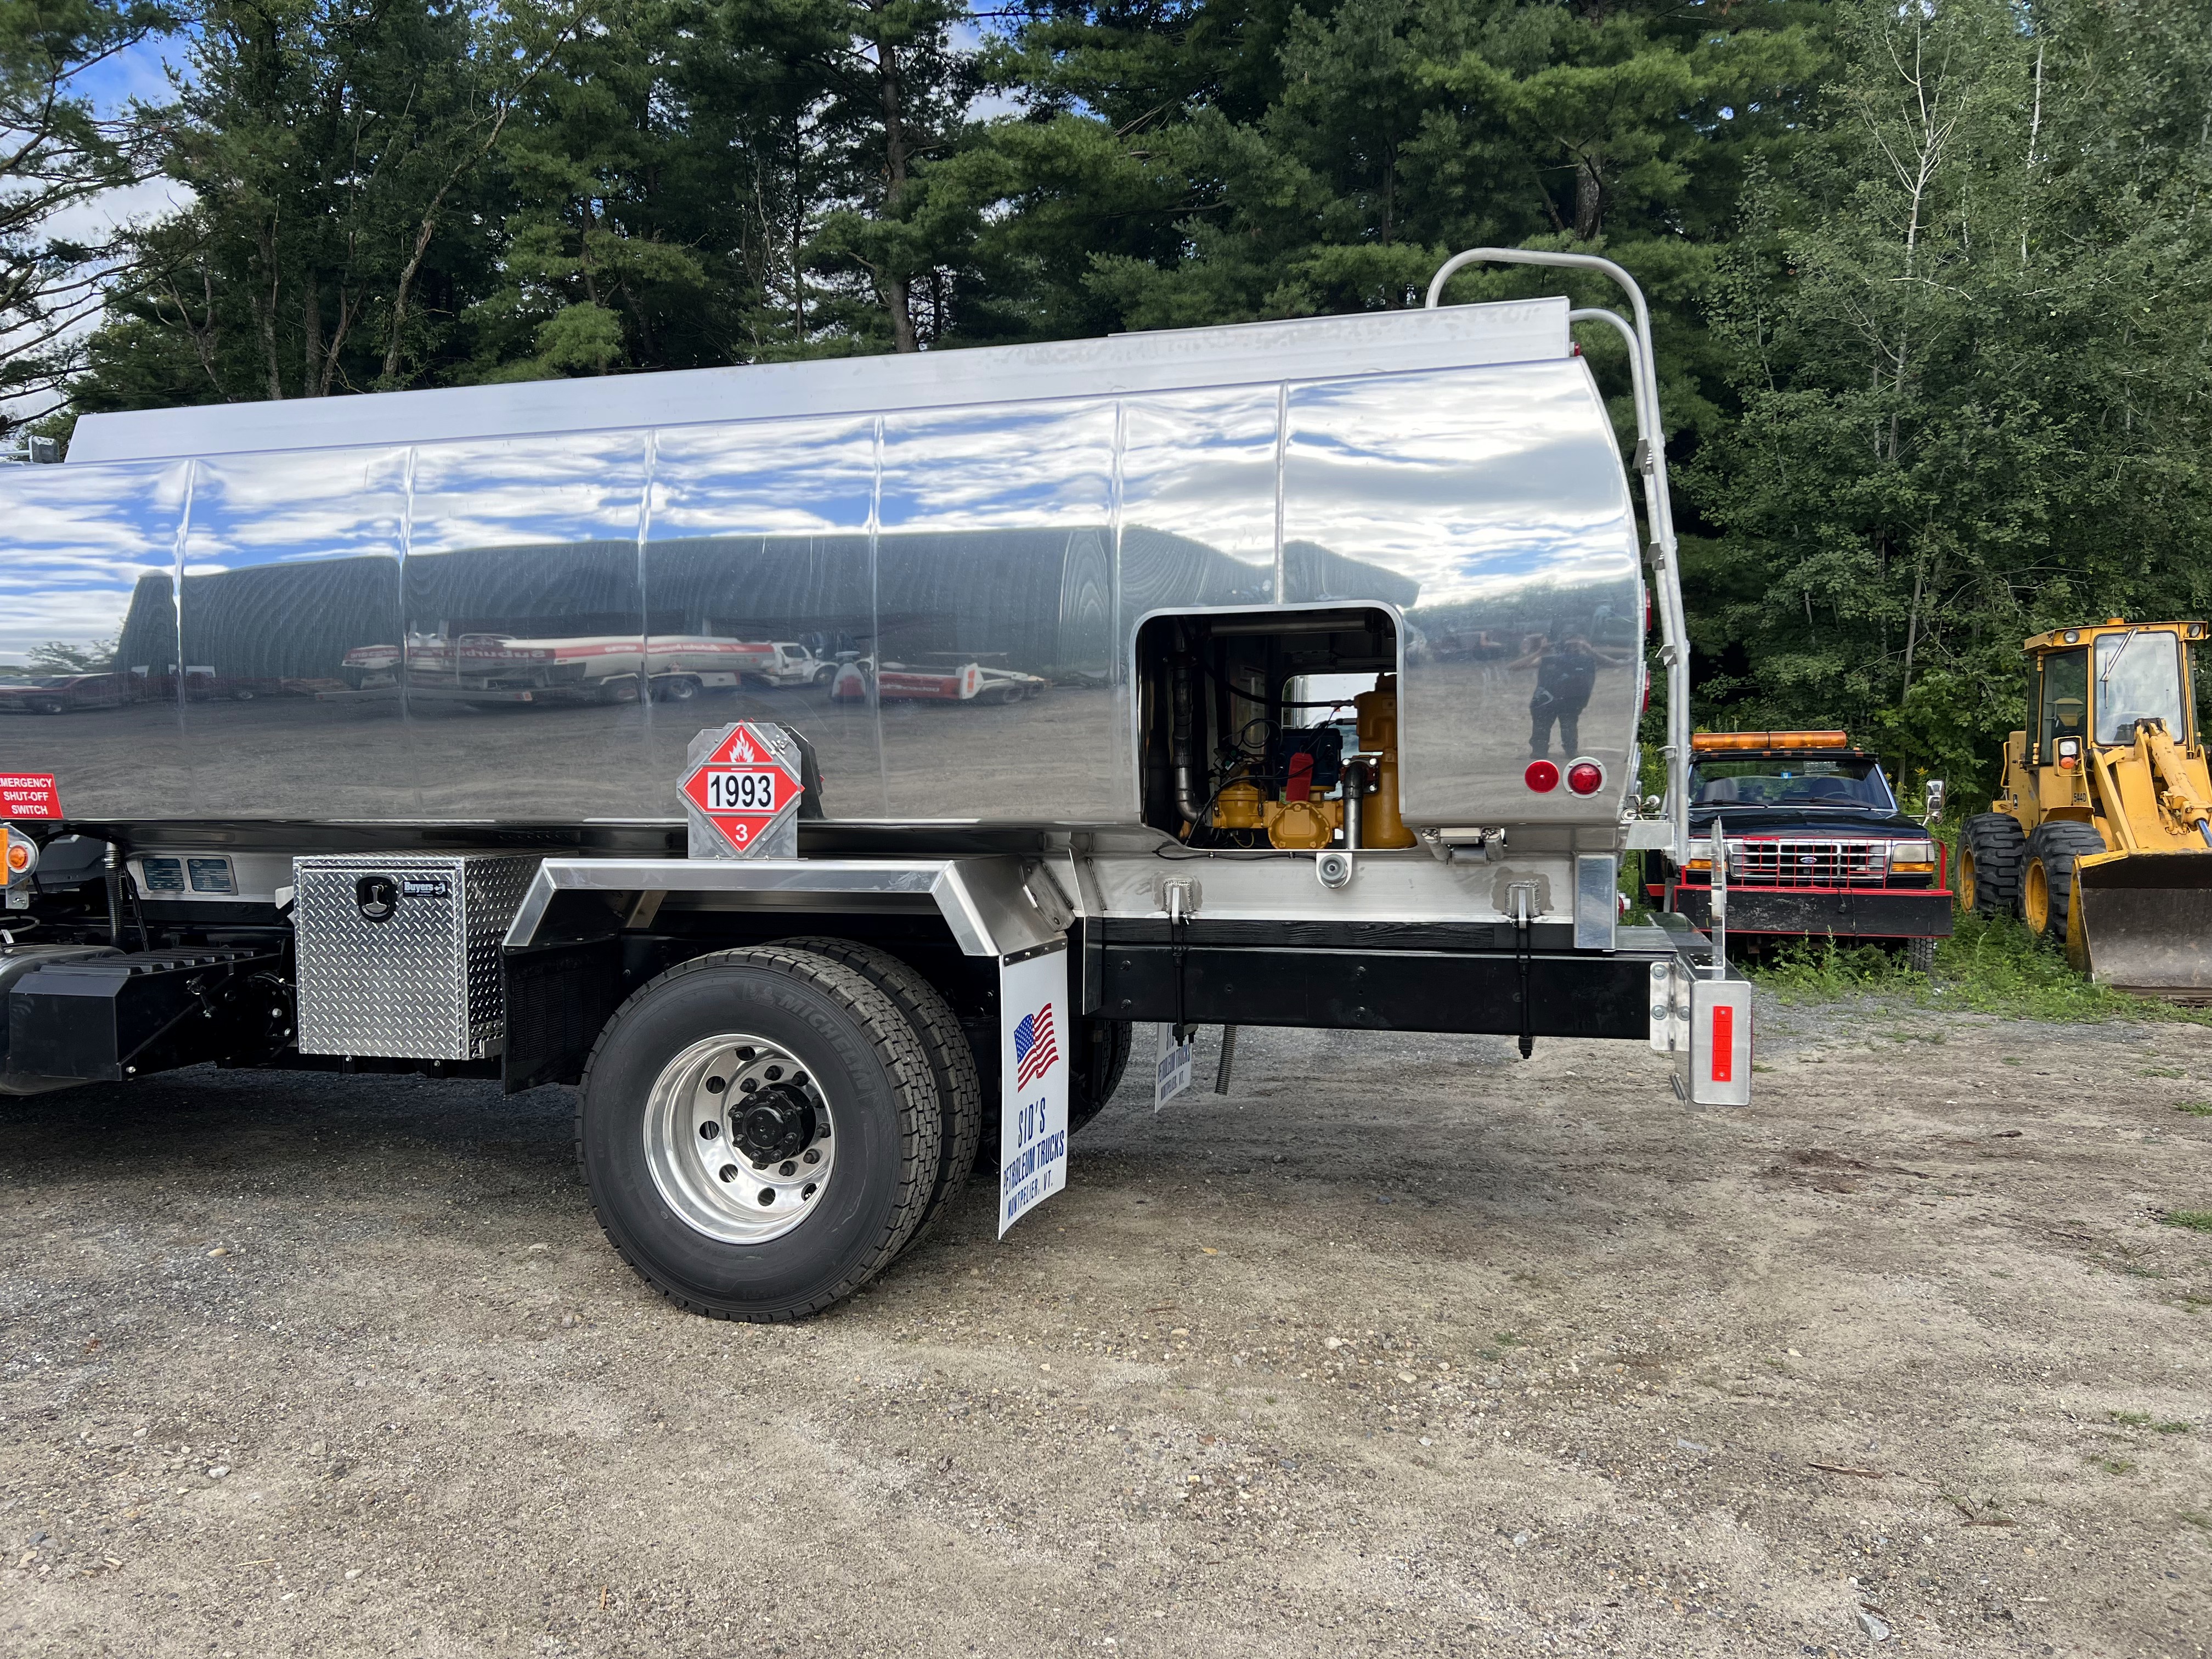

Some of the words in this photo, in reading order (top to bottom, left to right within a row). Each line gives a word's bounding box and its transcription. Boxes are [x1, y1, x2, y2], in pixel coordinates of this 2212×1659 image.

[3, 791, 49, 801] SHUT-OFF
[710, 775, 772, 808] 1993
[2074, 792, 2086, 803] 544D
[11, 804, 48, 815] SWITCH
[735, 823, 748, 842] 3
[404, 881, 434, 893] Buyers
[778, 994, 877, 1090] MICHELIN
[1018, 1097, 1046, 1149] SID'S
[1003, 1146, 1036, 1199] PETROLEUM
[1037, 1129, 1064, 1170] TRUCKS
[1043, 1169, 1053, 1191] VT.
